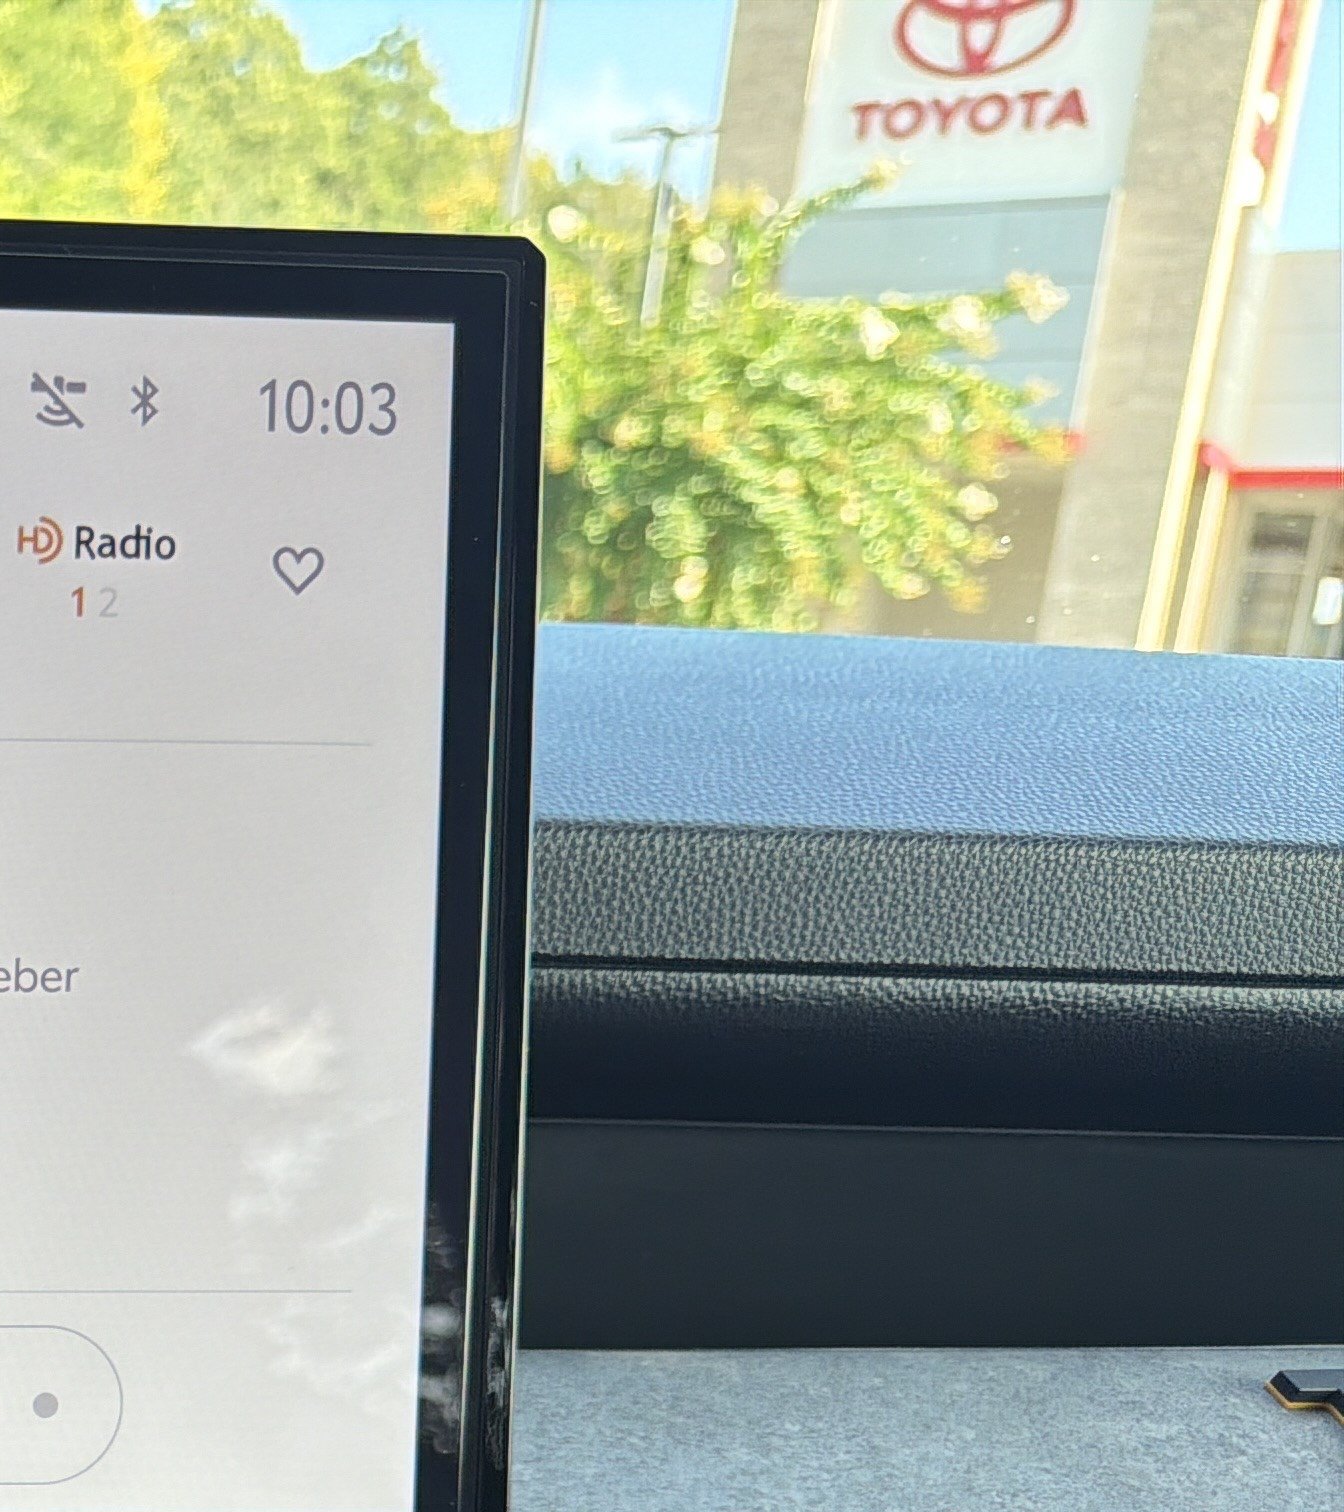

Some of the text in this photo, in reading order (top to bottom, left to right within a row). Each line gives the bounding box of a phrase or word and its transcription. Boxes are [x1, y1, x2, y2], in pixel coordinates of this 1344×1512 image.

[852, 88, 1089, 140] TOYOTA
[260, 379, 396, 436] 10:03
[74, 524, 176, 560] Radio
[71, 586, 118, 617] 1 2
